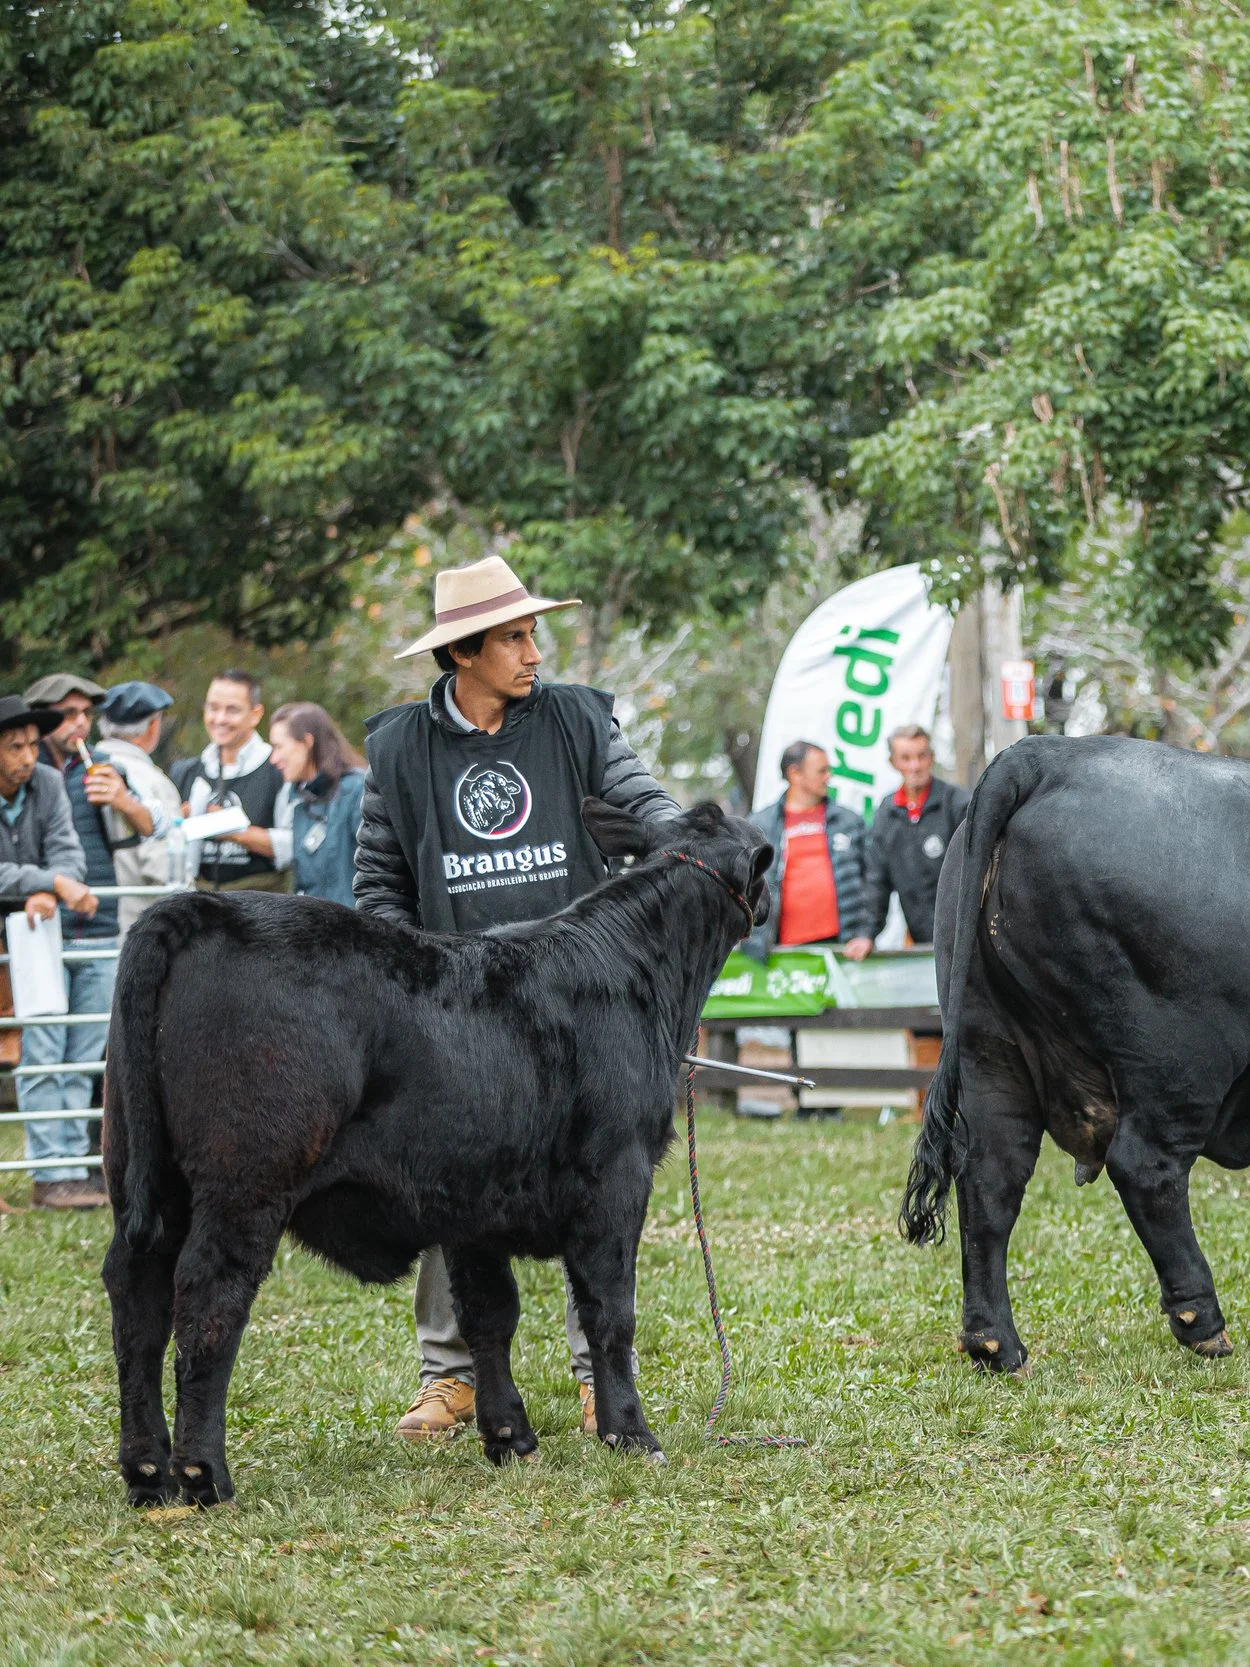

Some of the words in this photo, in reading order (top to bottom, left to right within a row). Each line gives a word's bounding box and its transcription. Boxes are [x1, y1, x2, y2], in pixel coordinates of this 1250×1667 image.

[828, 625, 901, 829] redi
[443, 841, 567, 879] Brangus
[447, 880, 486, 894] ASSOCIAÇÃO
[487, 875, 528, 888] BRASILEIRA
[529, 873, 538, 882] DE
[539, 868, 569, 881] BRANGUS
